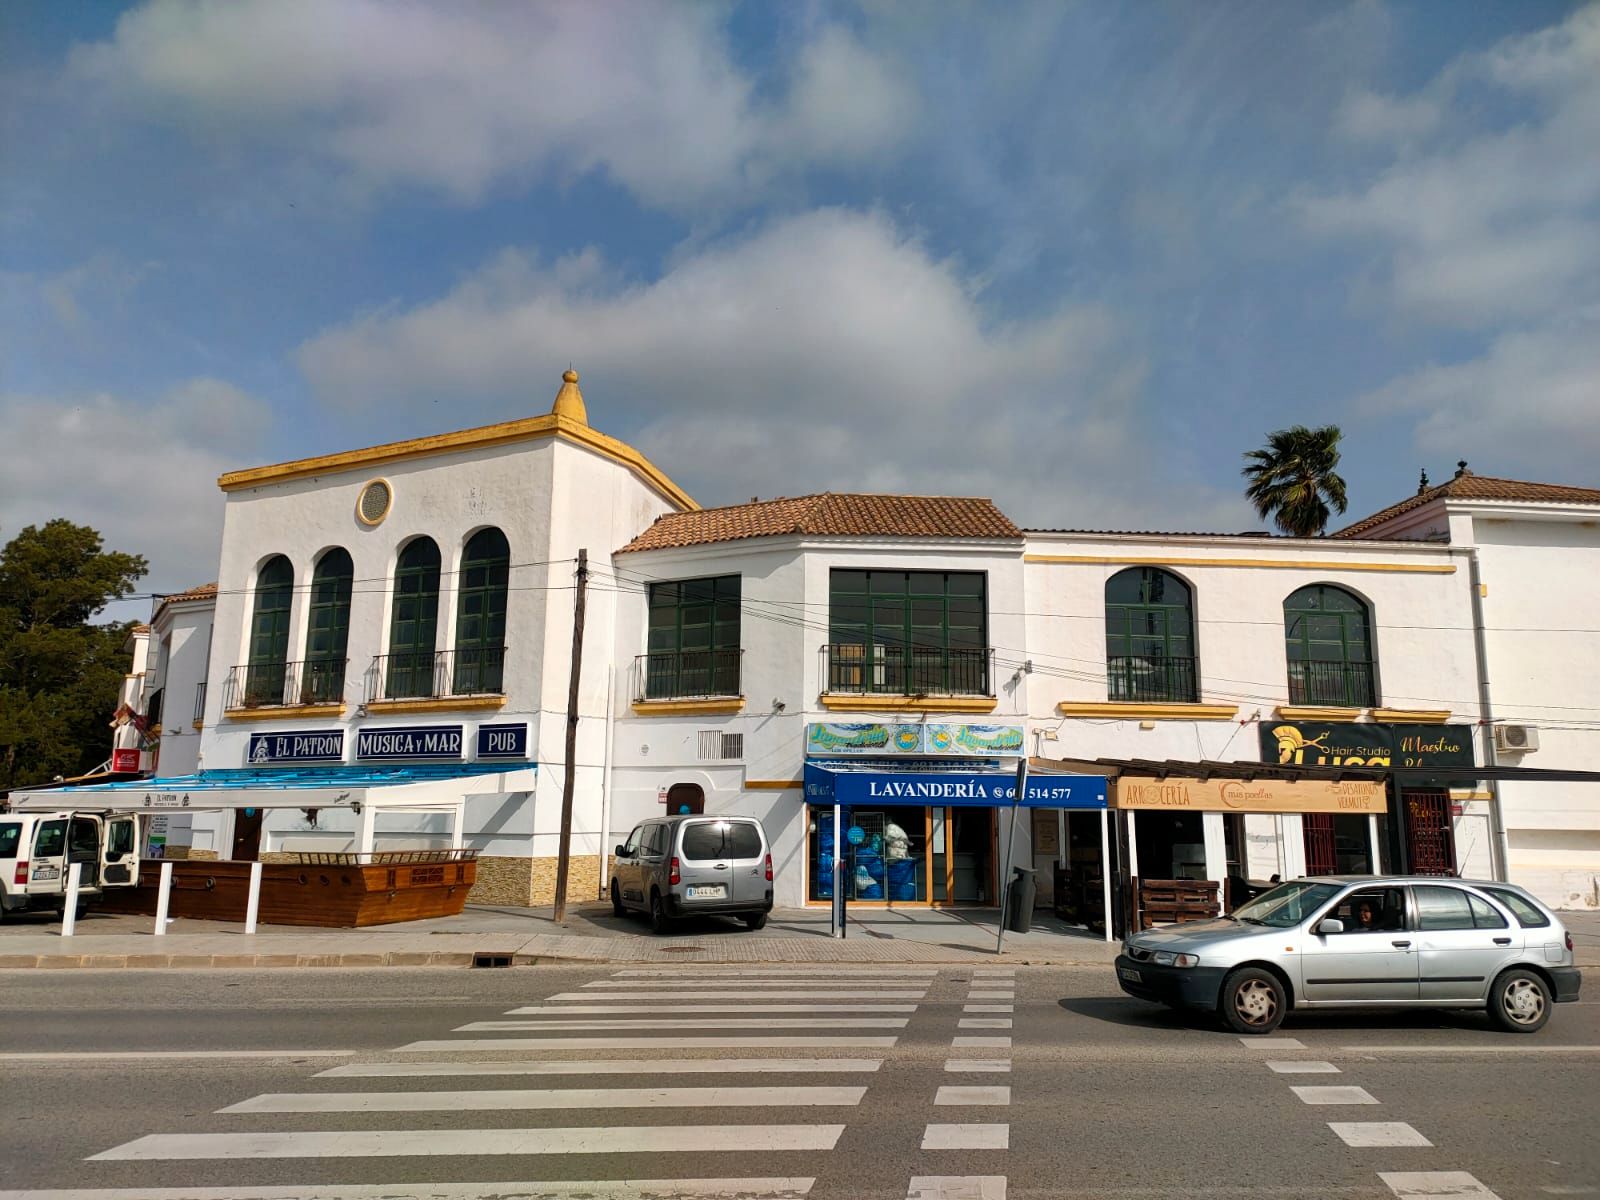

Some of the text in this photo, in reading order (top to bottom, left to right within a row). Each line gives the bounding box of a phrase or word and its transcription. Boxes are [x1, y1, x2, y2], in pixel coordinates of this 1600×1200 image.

[276, 734, 341, 756] EL PATRÓN
[360, 733, 414, 755] MÚSICA
[424, 733, 460, 752] MAR
[488, 733, 516, 751] PUB
[1331, 747, 1390, 756] Hair Studio
[1400, 736, 1460, 754] Maestro
[870, 779, 987, 798] LAVANDERÍA
[1028, 788, 1048, 799] 514
[1051, 788, 1071, 799] 577
